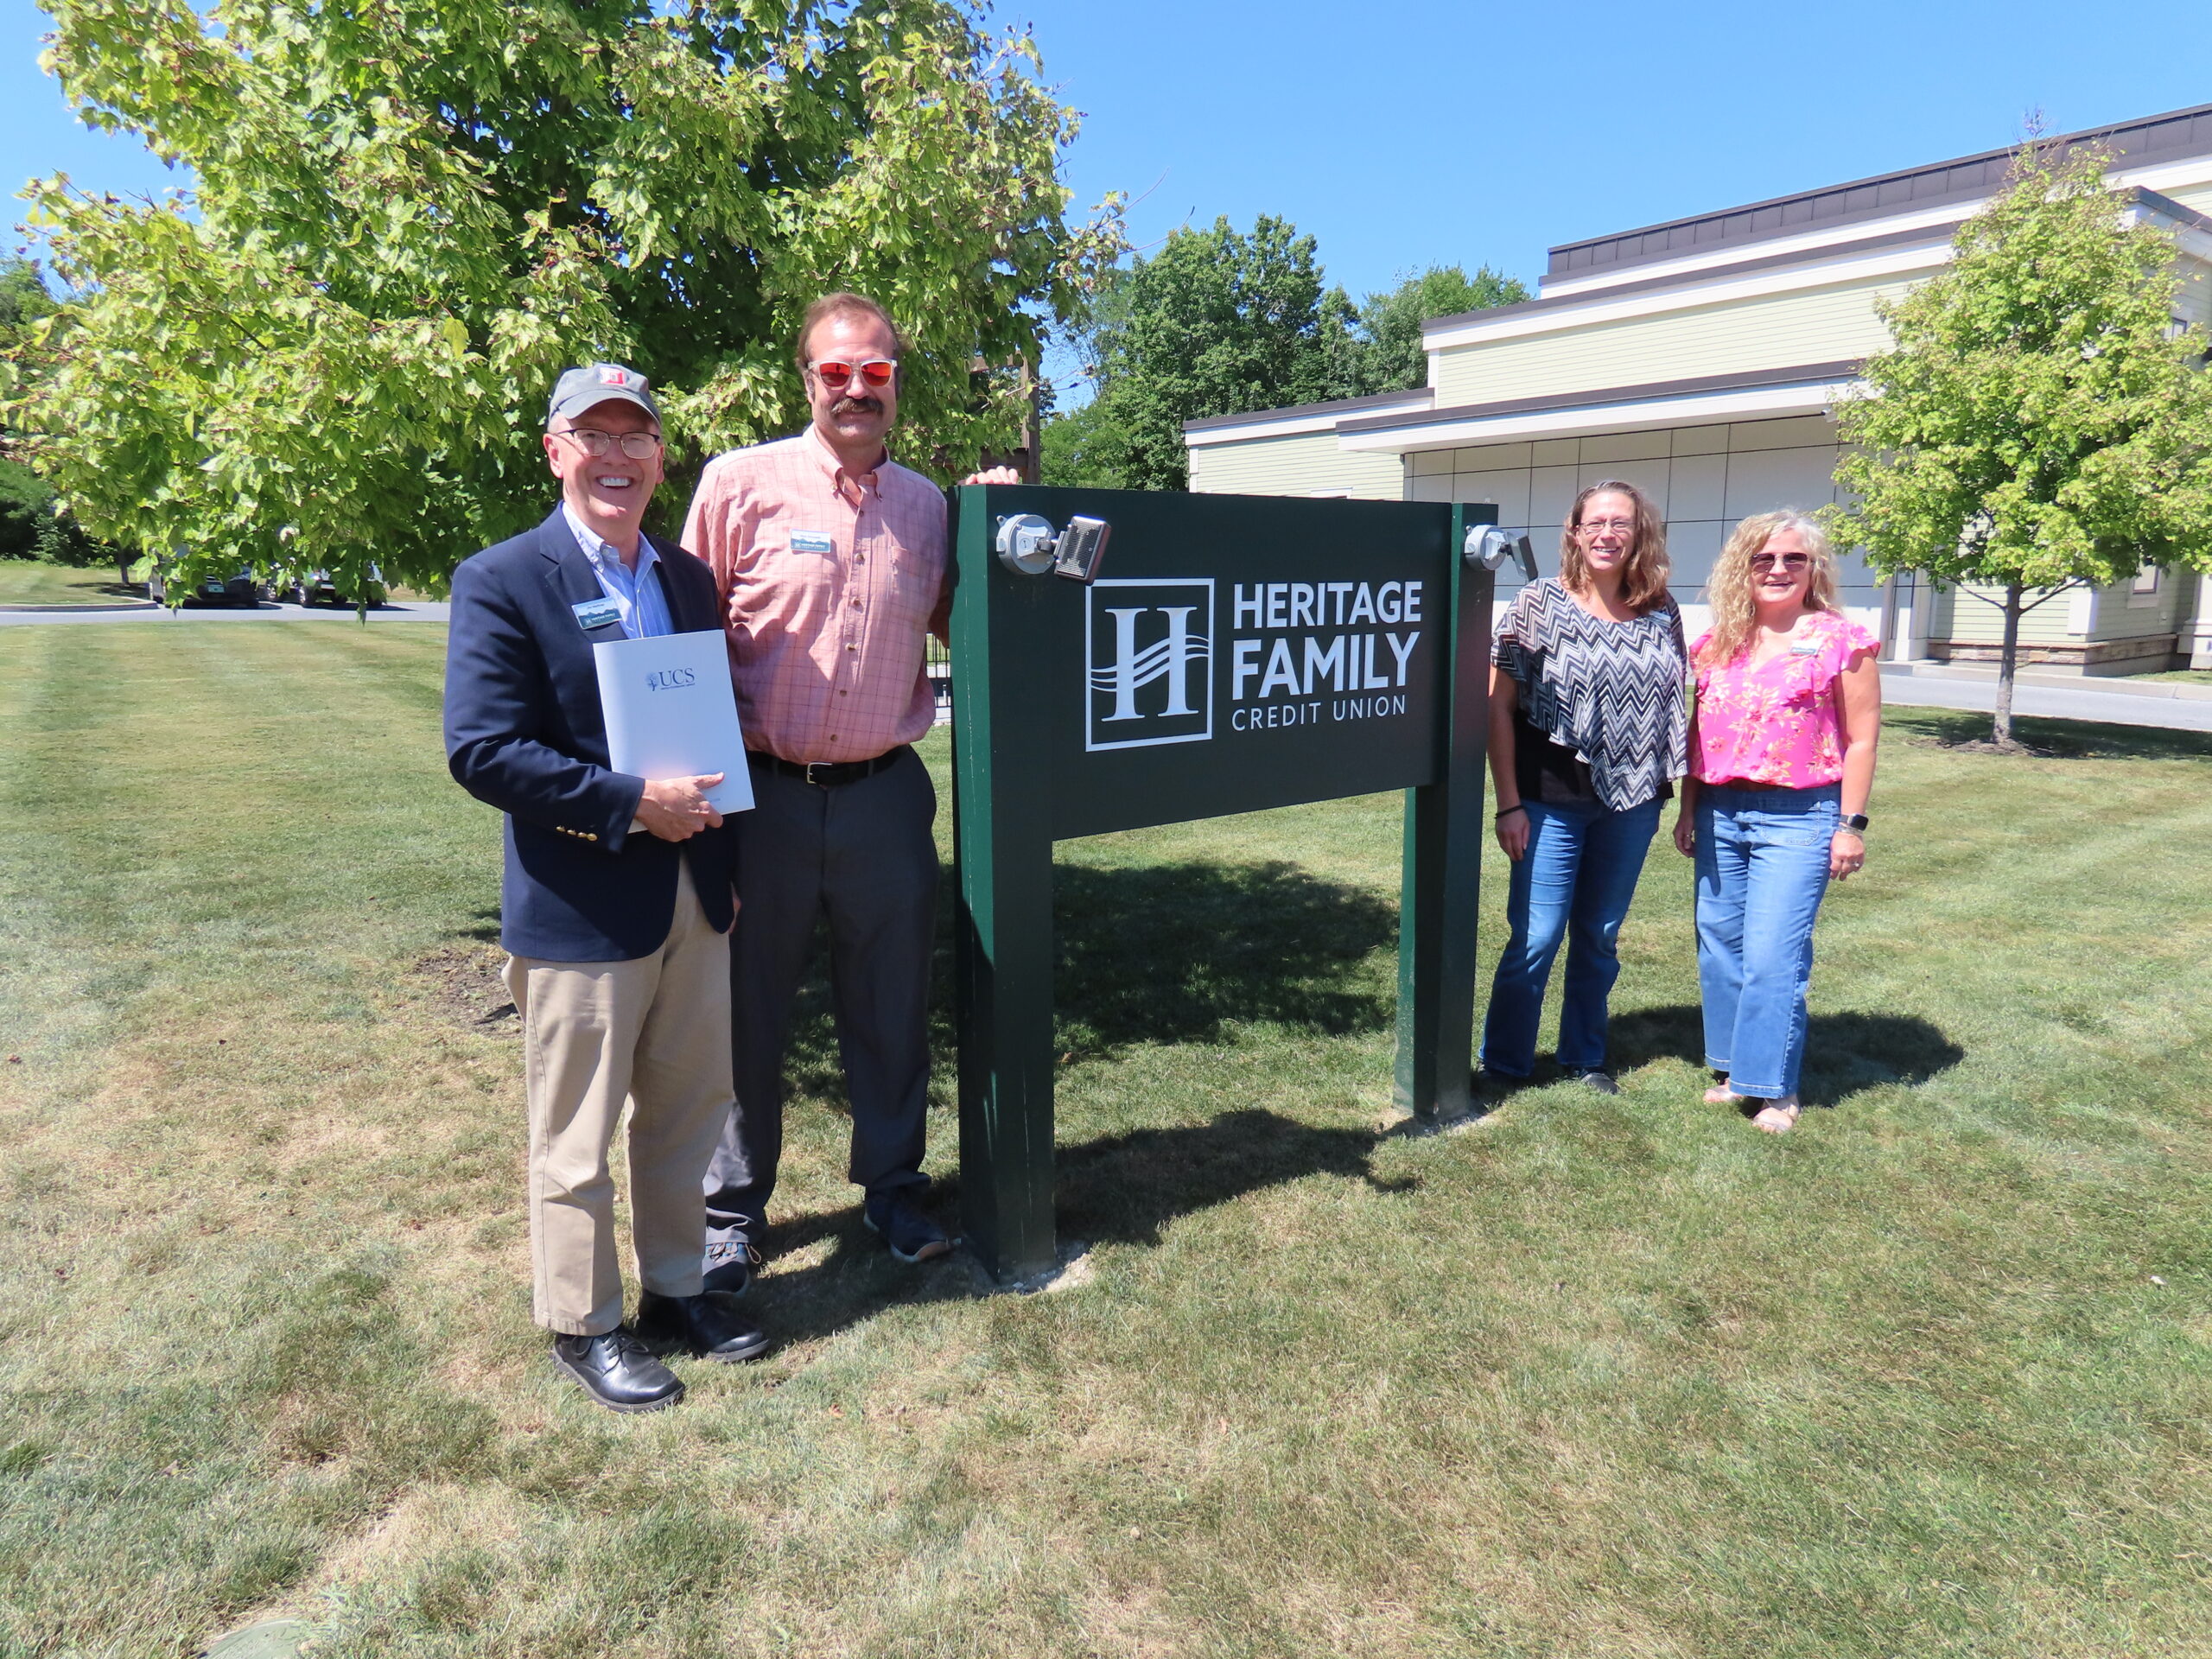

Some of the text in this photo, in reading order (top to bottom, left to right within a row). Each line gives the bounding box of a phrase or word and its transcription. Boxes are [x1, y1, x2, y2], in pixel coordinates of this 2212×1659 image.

[1233, 581, 1423, 630] HERITAGE
[658, 668, 696, 689] UCS
[1101, 607, 1200, 722] H
[1232, 631, 1421, 701] FAMILY
[1231, 694, 1406, 732] CREDIT UNION
